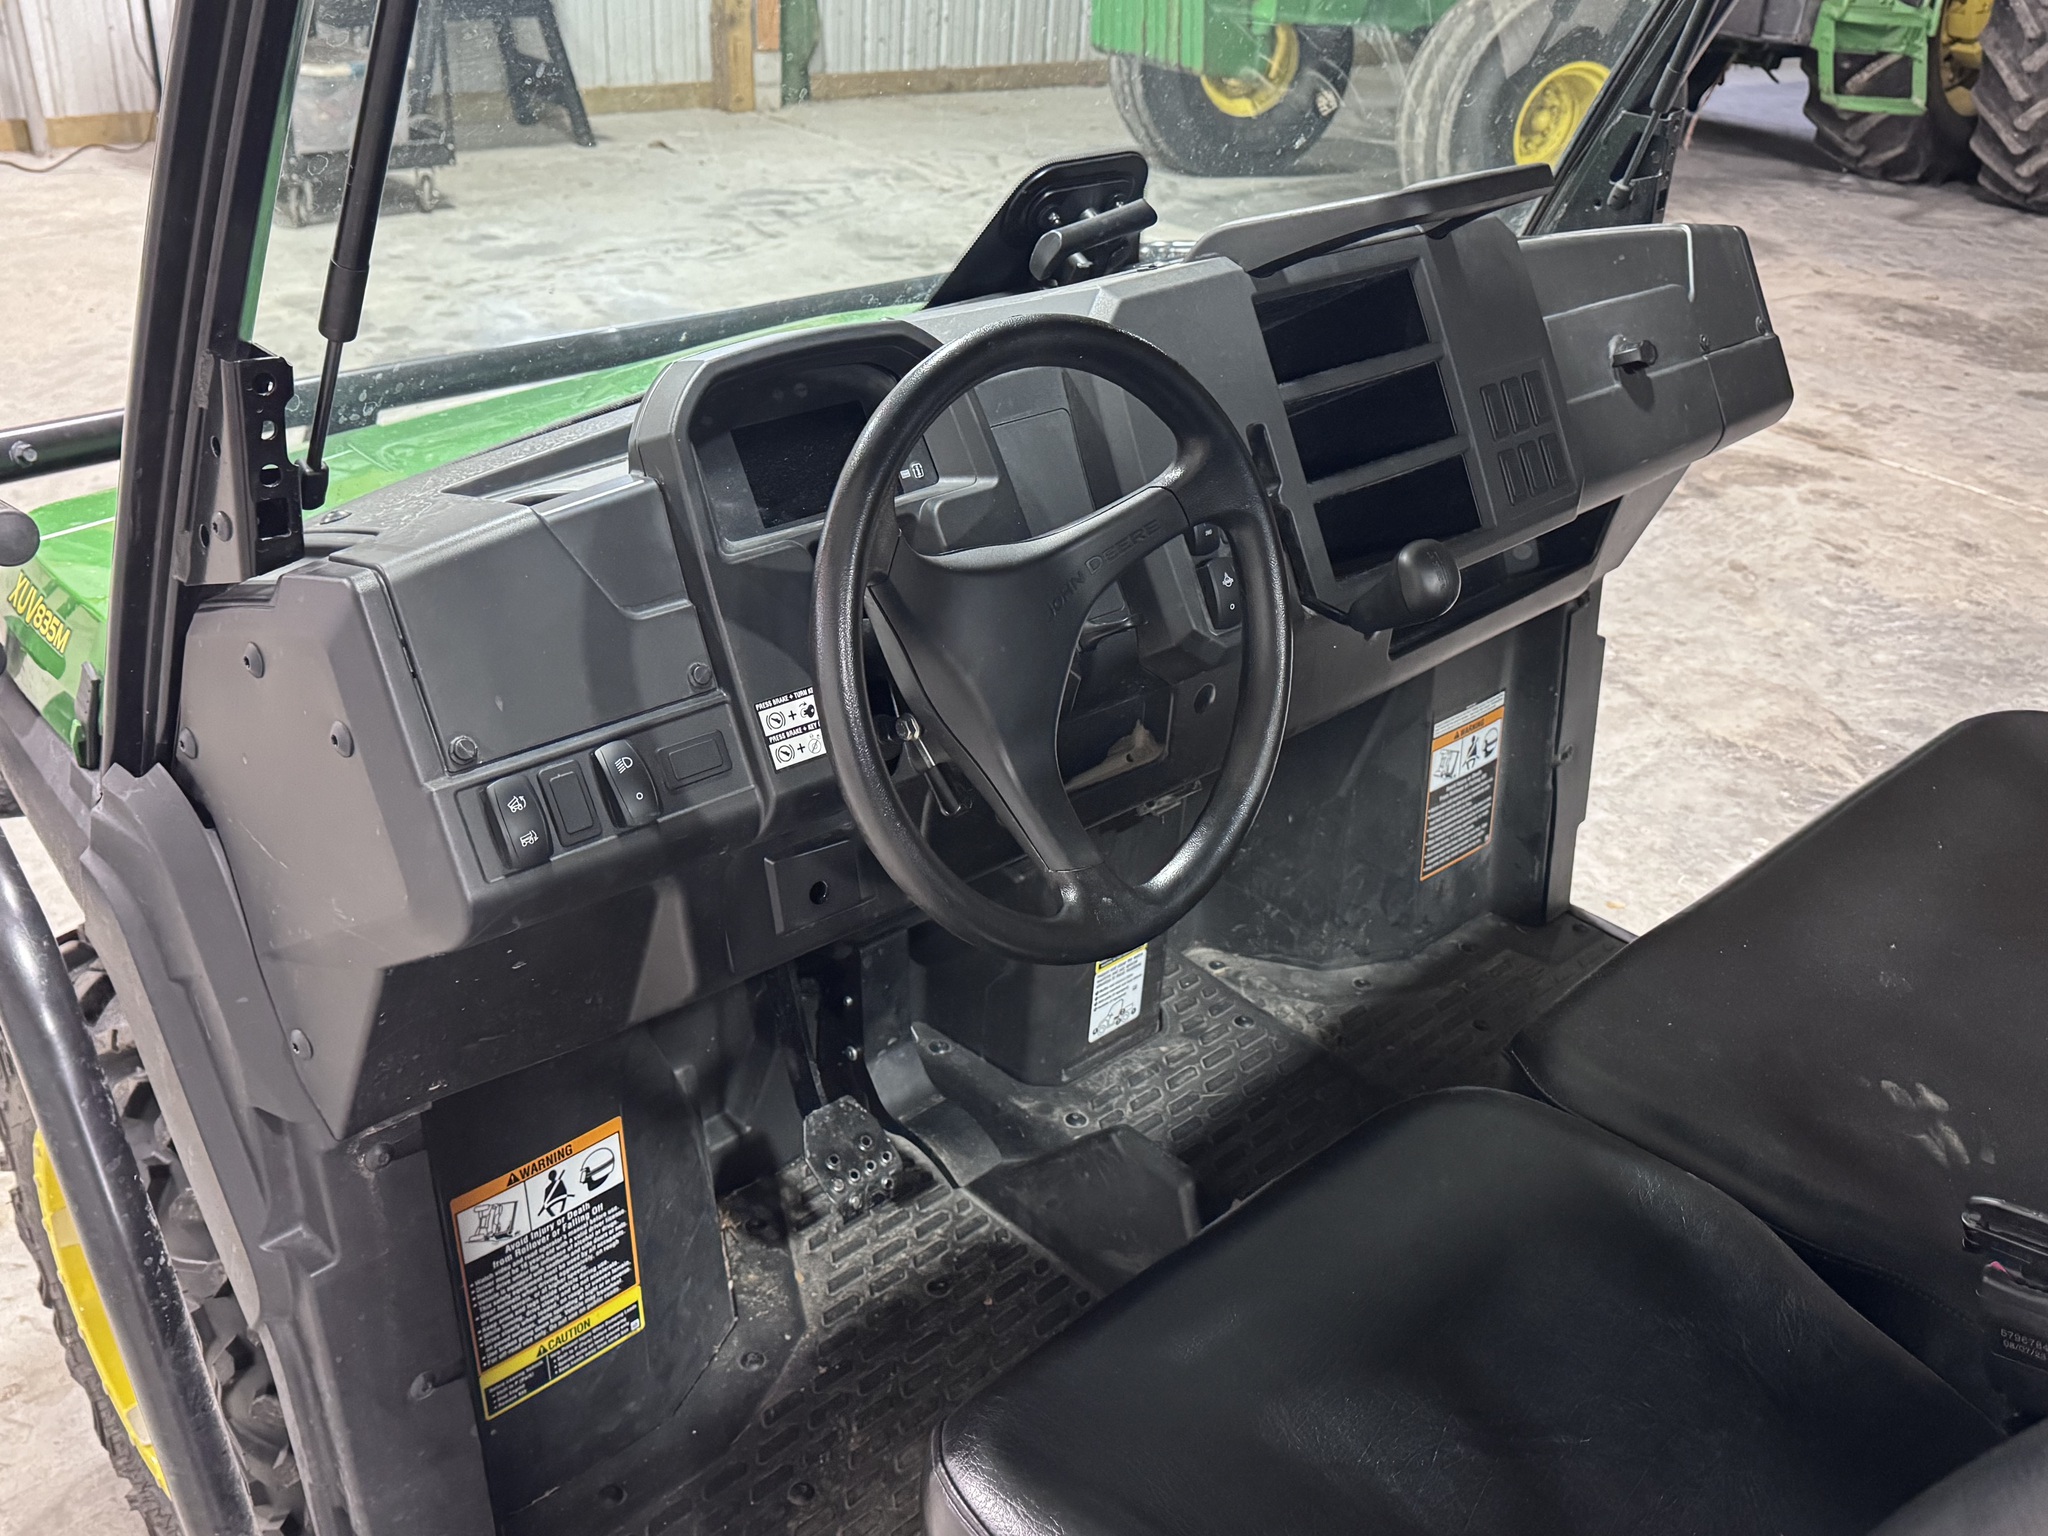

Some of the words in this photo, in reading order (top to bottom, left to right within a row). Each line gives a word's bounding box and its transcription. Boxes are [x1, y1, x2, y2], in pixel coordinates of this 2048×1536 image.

[1046, 569, 1087, 617] JOHN
[1085, 518, 1162, 575] DEERE
[8, 570, 72, 654] XUV835M
[755, 701, 772, 711] PRESS
[772, 694, 789, 706] BRAKE
[793, 688, 808, 699] TURN
[768, 732, 786, 743] PRESS
[785, 727, 803, 738] BRAKE
[519, 1144, 573, 1180] WARNING
[492, 1252, 512, 1269] from
[514, 1231, 550, 1258] Rollover
[551, 1227, 560, 1237] or
[562, 1210, 590, 1232] Falling
[591, 1202, 603, 1215] Off
[504, 1234, 528, 1254] Avoid
[529, 1220, 554, 1241] Injury
[556, 1215, 565, 1225] or
[566, 1200, 590, 1220] Death
[547, 1317, 591, 1351] CAUTION
